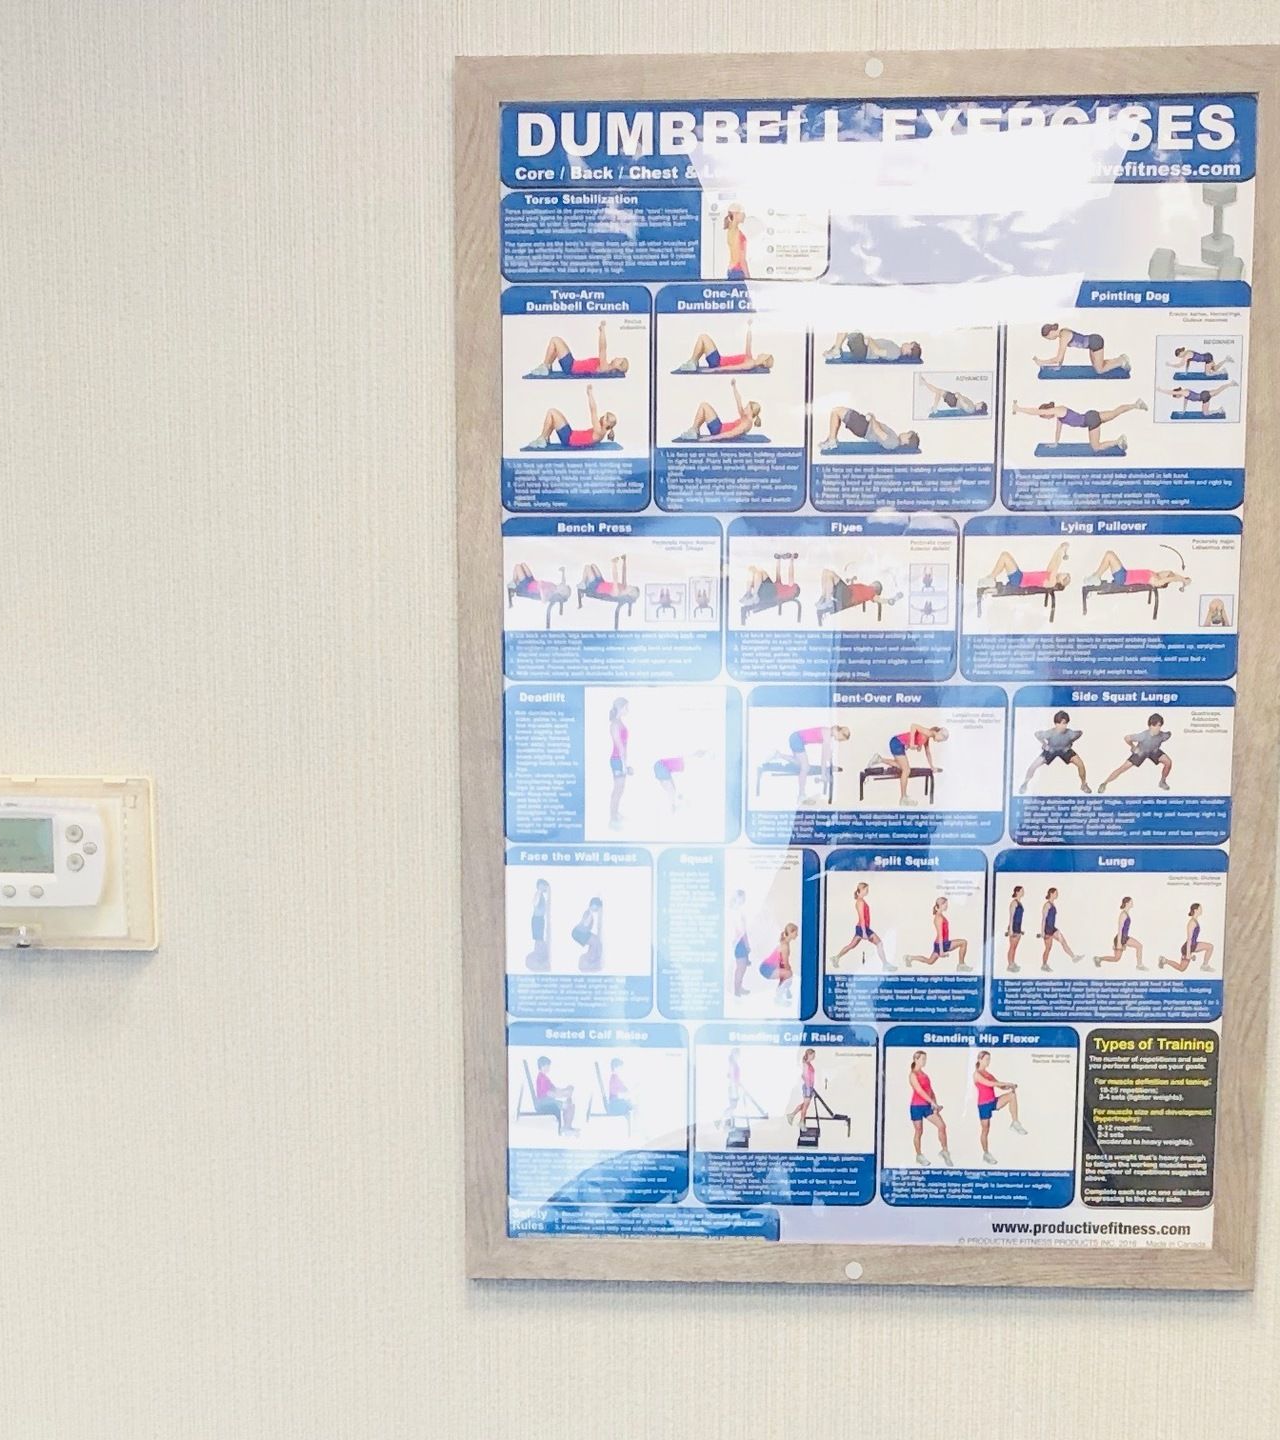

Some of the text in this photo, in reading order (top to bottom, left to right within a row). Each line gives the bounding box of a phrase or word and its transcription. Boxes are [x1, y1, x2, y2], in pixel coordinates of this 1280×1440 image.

[515, 166, 555, 180] Core
[559, 167, 566, 180] /
[571, 166, 613, 180] Back
[629, 166, 679, 180] Chest
[684, 166, 698, 180] &
[524, 194, 638, 205] Torso Stabilization
[550, 289, 605, 301] Two-Arm
[1091, 290, 1170, 304] Pointing Dog
[526, 301, 630, 312] Dumbbell Crunch
[677, 300, 742, 311] Dumbbell
[557, 522, 632, 533] Bench Press
[831, 522, 863, 534] Flyes
[1060, 521, 1148, 534] Lying Pullover
[519, 692, 566, 703] Deadlift
[832, 693, 922, 703] Bent-Over Row
[1072, 691, 1178, 704] Side Squat Lunge
[520, 852, 637, 865] Face the Wall Squat
[679, 853, 713, 866] Squat
[874, 855, 939, 867] Split Squat
[1098, 856, 1136, 869] Lunge
[544, 1028, 648, 1041] Seated Calf Raise
[729, 1031, 844, 1046] Standing Calf Raise
[923, 1033, 1040, 1045] Standing Hip Flexor
[1093, 1037, 1215, 1053] Types of Training
[1089, 1055, 1102, 1063] The
[1103, 1055, 1130, 1063] number
[1131, 1055, 1139, 1063] of
[1139, 1056, 1177, 1064] repetitions
[1165, 1109, 1212, 1117] development
[1141, 1139, 1162, 1147] heavy
[1113, 1154, 1137, 1162] weight
[1158, 1154, 1180, 1162] heavy
[1180, 1154, 1206, 1162] enough
[1084, 1188, 1117, 1196] Complete
[511, 1207, 547, 1221] Safety
[512, 1220, 544, 1231] Rules
[991, 1221, 1191, 1236] www.productivefitness.com
[966, 1237, 1019, 1245] PRODUCTIVE
[1054, 1238, 1099, 1246] PRODUCTS
[1178, 1240, 1206, 1248] Canada
